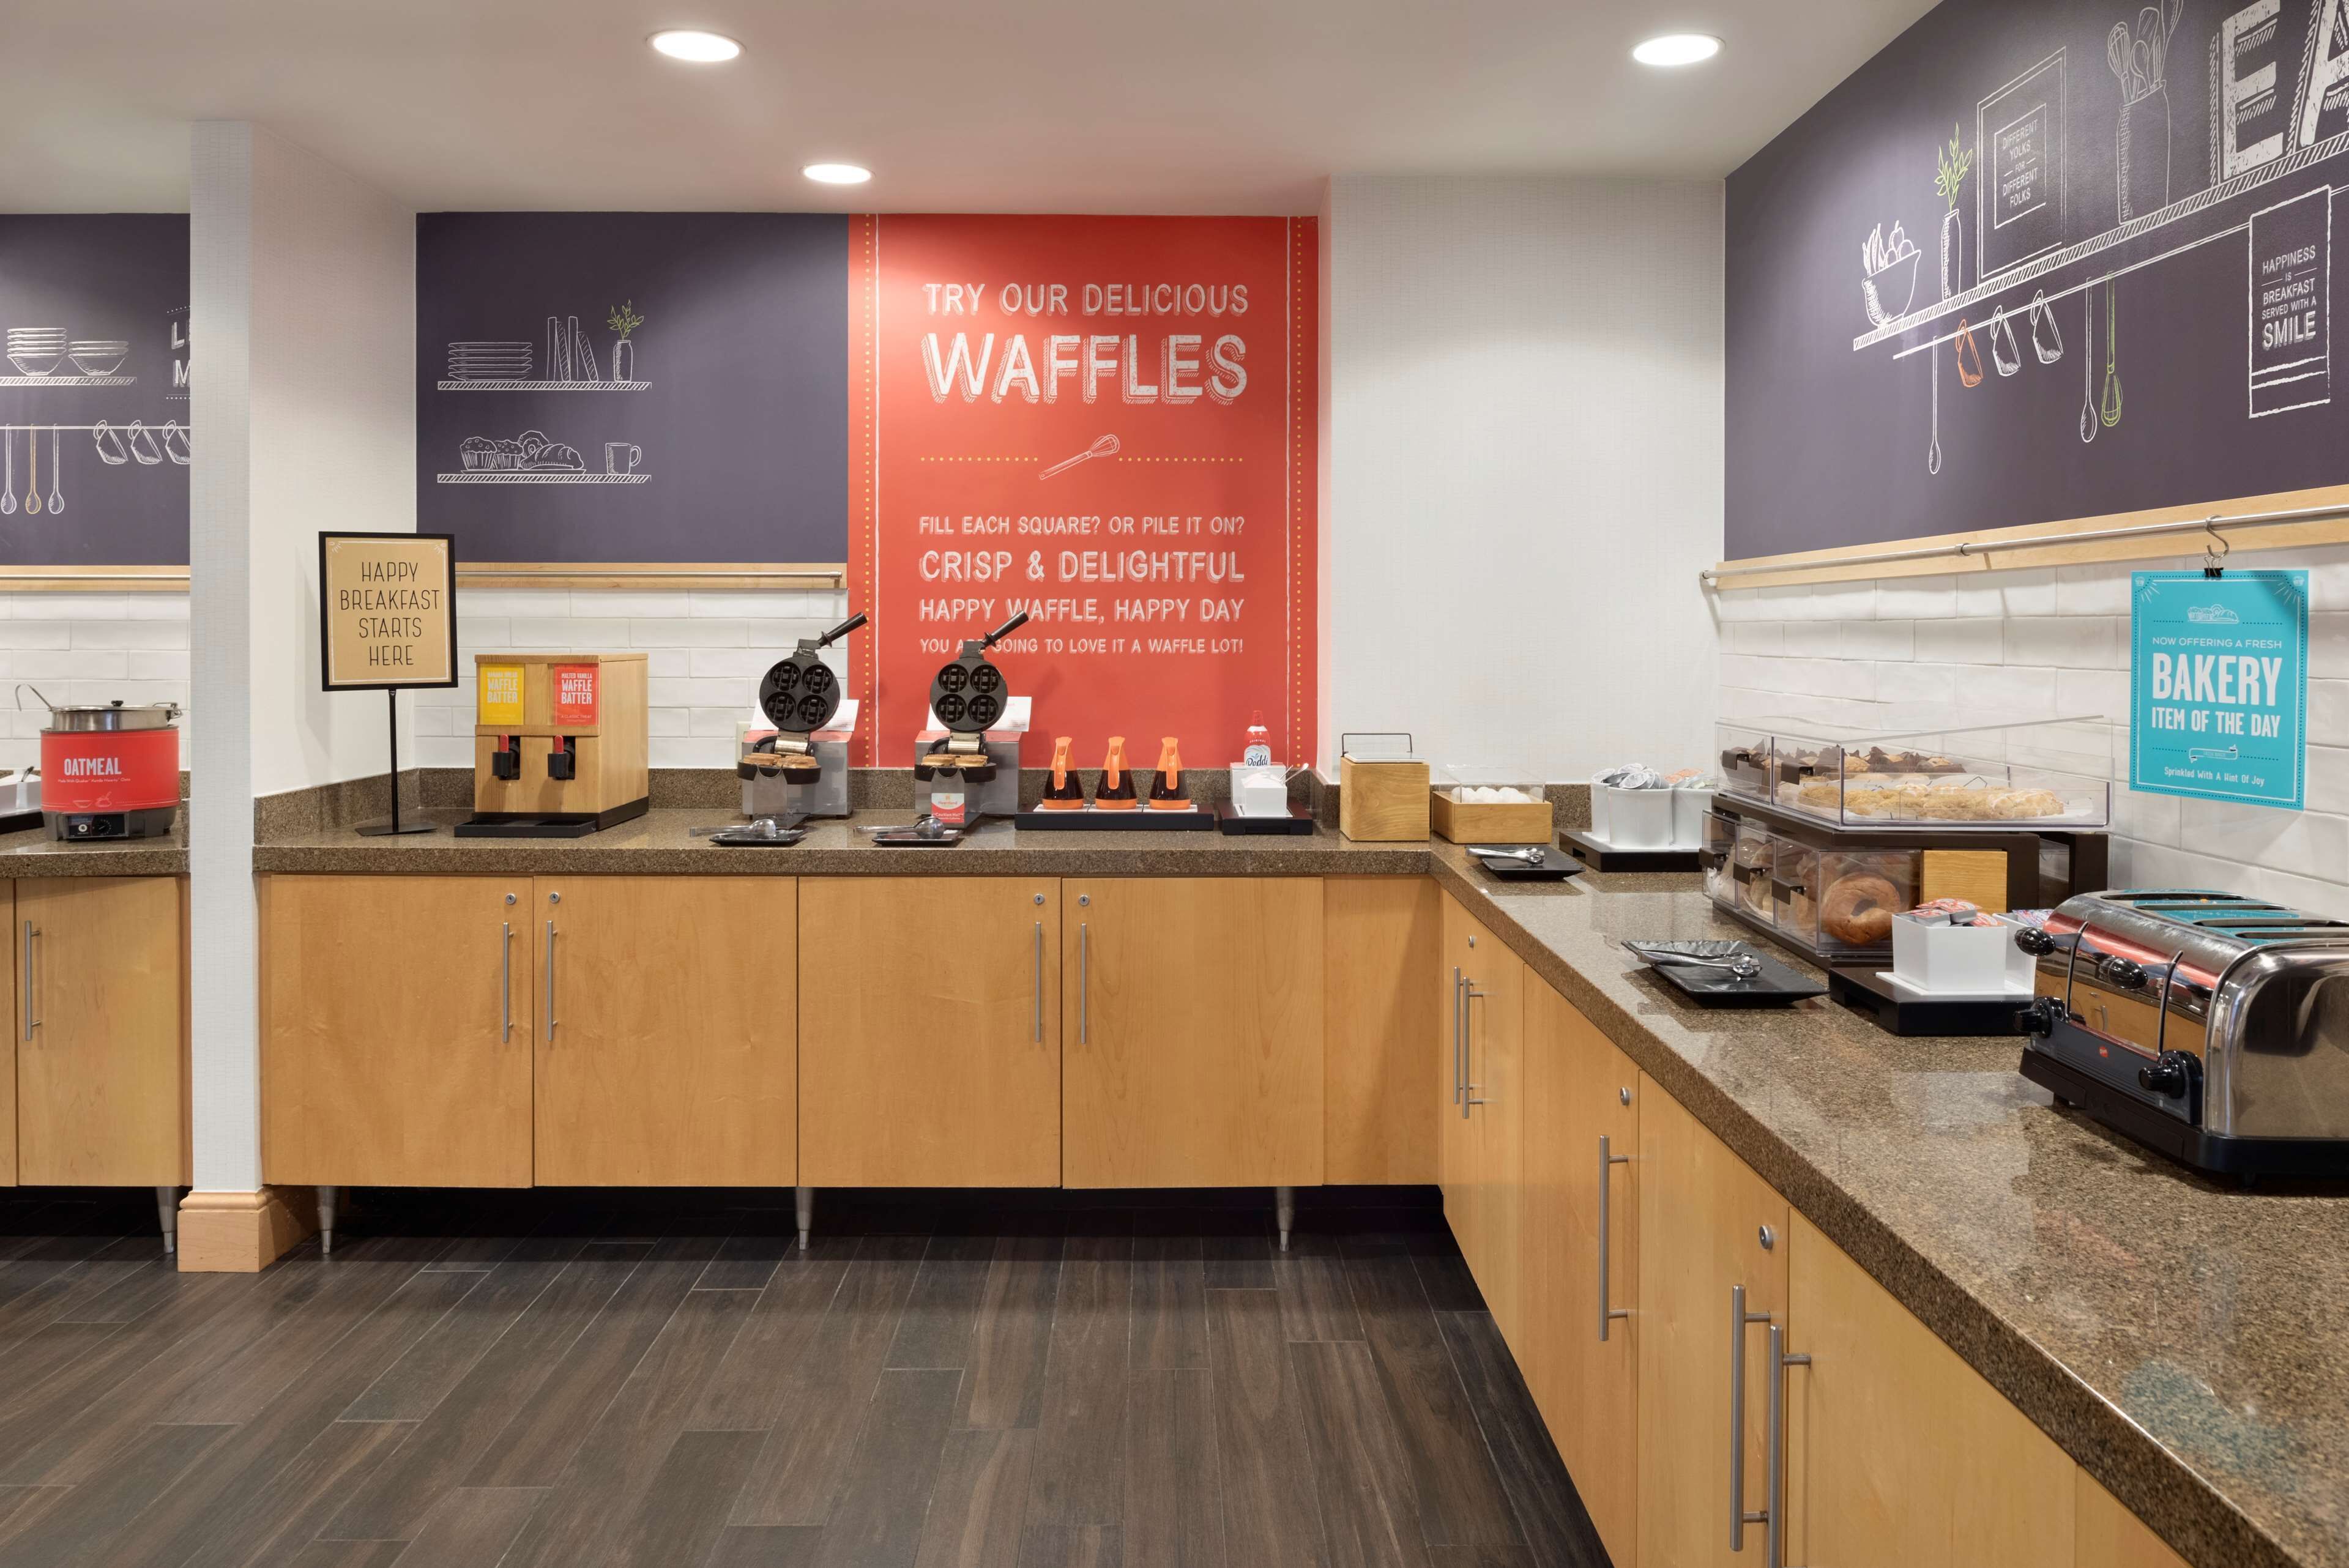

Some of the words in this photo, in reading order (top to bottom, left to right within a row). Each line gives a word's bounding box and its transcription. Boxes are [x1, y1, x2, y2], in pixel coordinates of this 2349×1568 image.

[2003, 119, 2038, 149] DIFFERENT
[2009, 139, 2031, 161] YOLKS
[2015, 161, 2025, 173] FOR
[2003, 168, 2038, 196] DIFFERENT
[2009, 188, 2031, 209] FOLKS
[2262, 245, 2316, 275] HAPPINESS
[2285, 272, 2291, 282] IS
[922, 283, 985, 316] TRY
[999, 283, 1068, 316] OUR
[1082, 283, 1249, 317] DELICIOUS
[2263, 278, 2315, 306] BREAKFAST
[2262, 303, 2288, 320] SERVED
[2291, 298, 2309, 311] WITH
[2311, 295, 2317, 307] A
[2262, 311, 2316, 351] SMILE
[920, 332, 1248, 406] WAFFLES
[919, 516, 954, 535] FILL
[961, 516, 1010, 535] EACH
[1017, 516, 1100, 535] SQUARE?
[1108, 516, 1135, 535] OR
[1142, 516, 1180, 535] PILE
[1186, 516, 1203, 535] IT
[1209, 516, 1245, 535] ON?
[362, 562, 417, 582] HAPPY
[919, 550, 1012, 582] CRISP
[1028, 550, 1045, 581] &
[1059, 550, 1245, 582] DELIGHTFUL
[340, 590, 440, 609] BREAKFAST
[919, 598, 996, 622] HAPPY
[1007, 598, 1106, 625] WAFFLE,
[1114, 598, 1189, 622] HAPPY
[1200, 598, 1245, 622] DAY
[359, 617, 422, 637] STARTS
[920, 639, 948, 654] YOU
[1045, 639, 1064, 654] TO
[1069, 639, 1106, 654] LOVE
[1112, 639, 1125, 654] IT
[1131, 639, 1142, 654] A
[1148, 639, 1205, 654] WAFFLE
[1212, 639, 1243, 654] LOT!
[2153, 637, 2177, 646] NOW
[2178, 637, 2233, 647] OFFERING
[2235, 639, 2243, 648] A
[2246, 639, 2282, 648] FRESH
[369, 645, 414, 665] HERE
[488, 678, 518, 690] WAFFLE
[562, 680, 592, 691] WAFFLE
[2152, 653, 2282, 706] BAKERY
[487, 691, 518, 703] BATTER
[561, 693, 592, 704] BATTER
[2152, 707, 2184, 730] ITEM
[2191, 709, 2209, 732] OF
[2216, 711, 2244, 735] THE
[2251, 714, 2281, 738] DAY
[64, 757, 122, 776] OATMEAL
[2164, 767, 2194, 779] Sprinkled
[2197, 769, 2213, 779] With
[2216, 770, 2221, 781] A
[2224, 771, 2239, 782] Hint
[2241, 773, 2249, 784] Of
[2251, 774, 2264, 787] Joy
